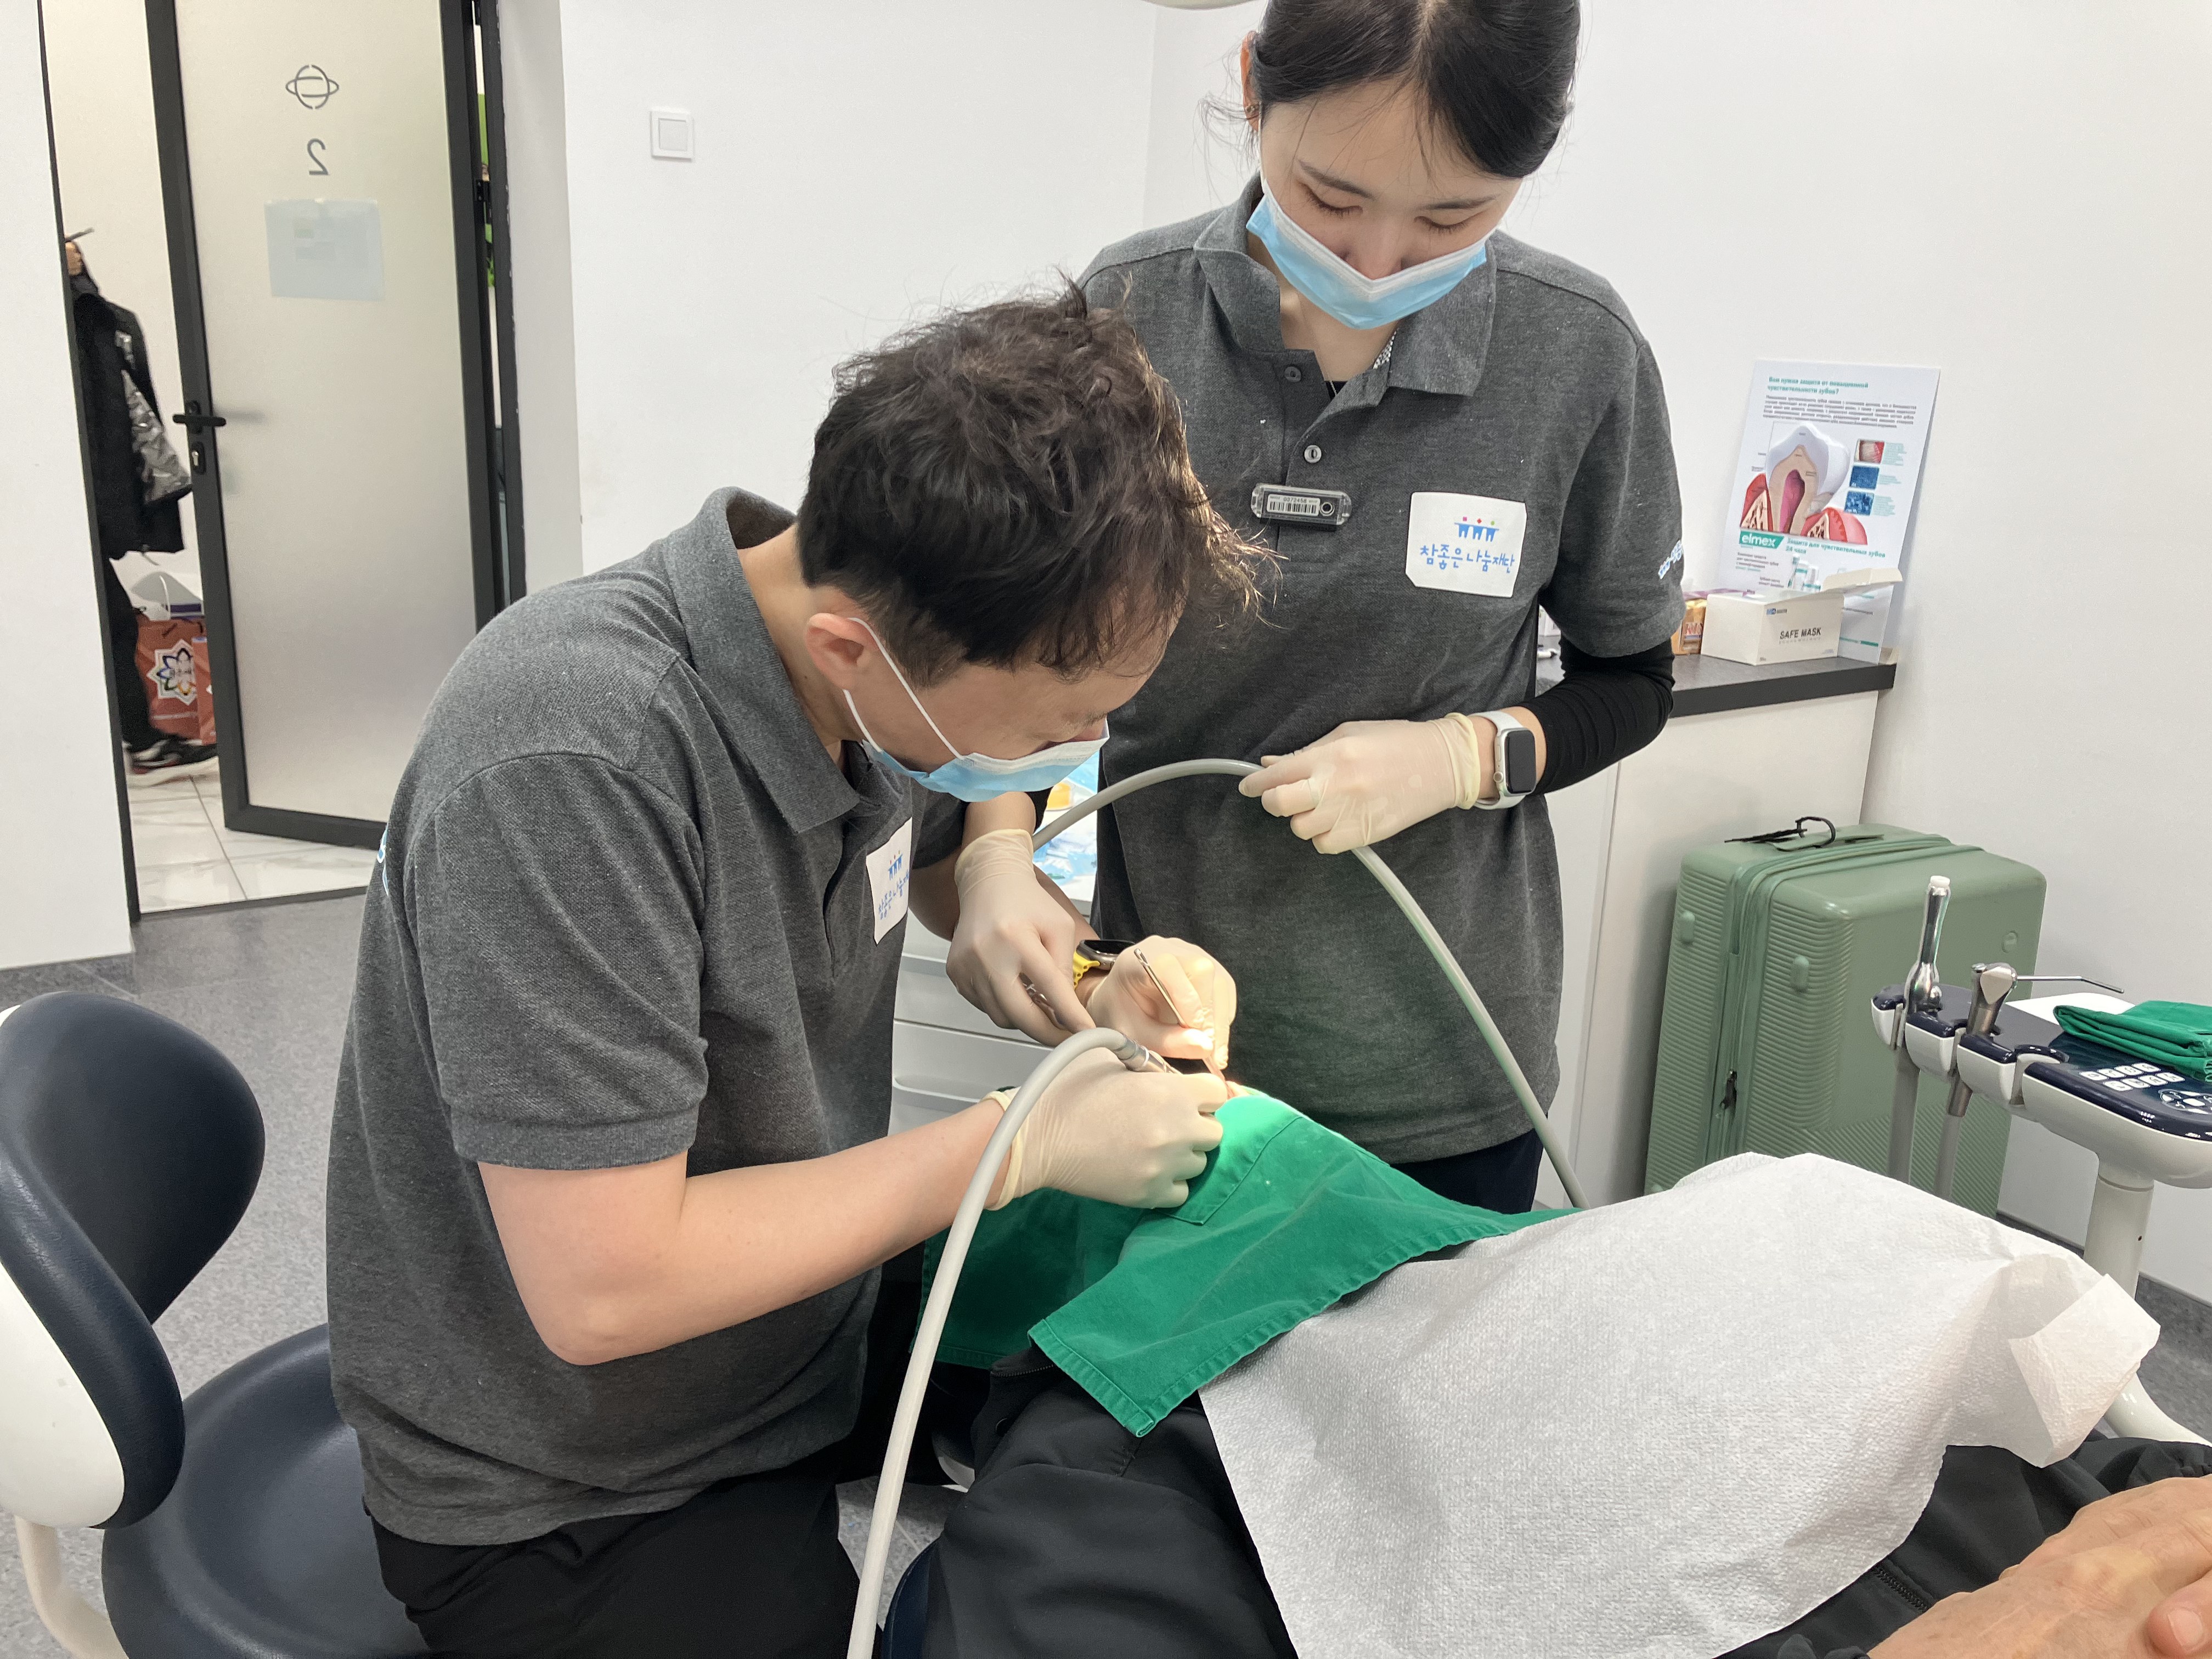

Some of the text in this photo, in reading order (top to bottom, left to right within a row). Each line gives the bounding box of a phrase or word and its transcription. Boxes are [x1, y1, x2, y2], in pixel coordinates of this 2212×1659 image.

[1741, 533, 1776, 548] elmex
[1779, 627, 1822, 640] SAFE MASK
